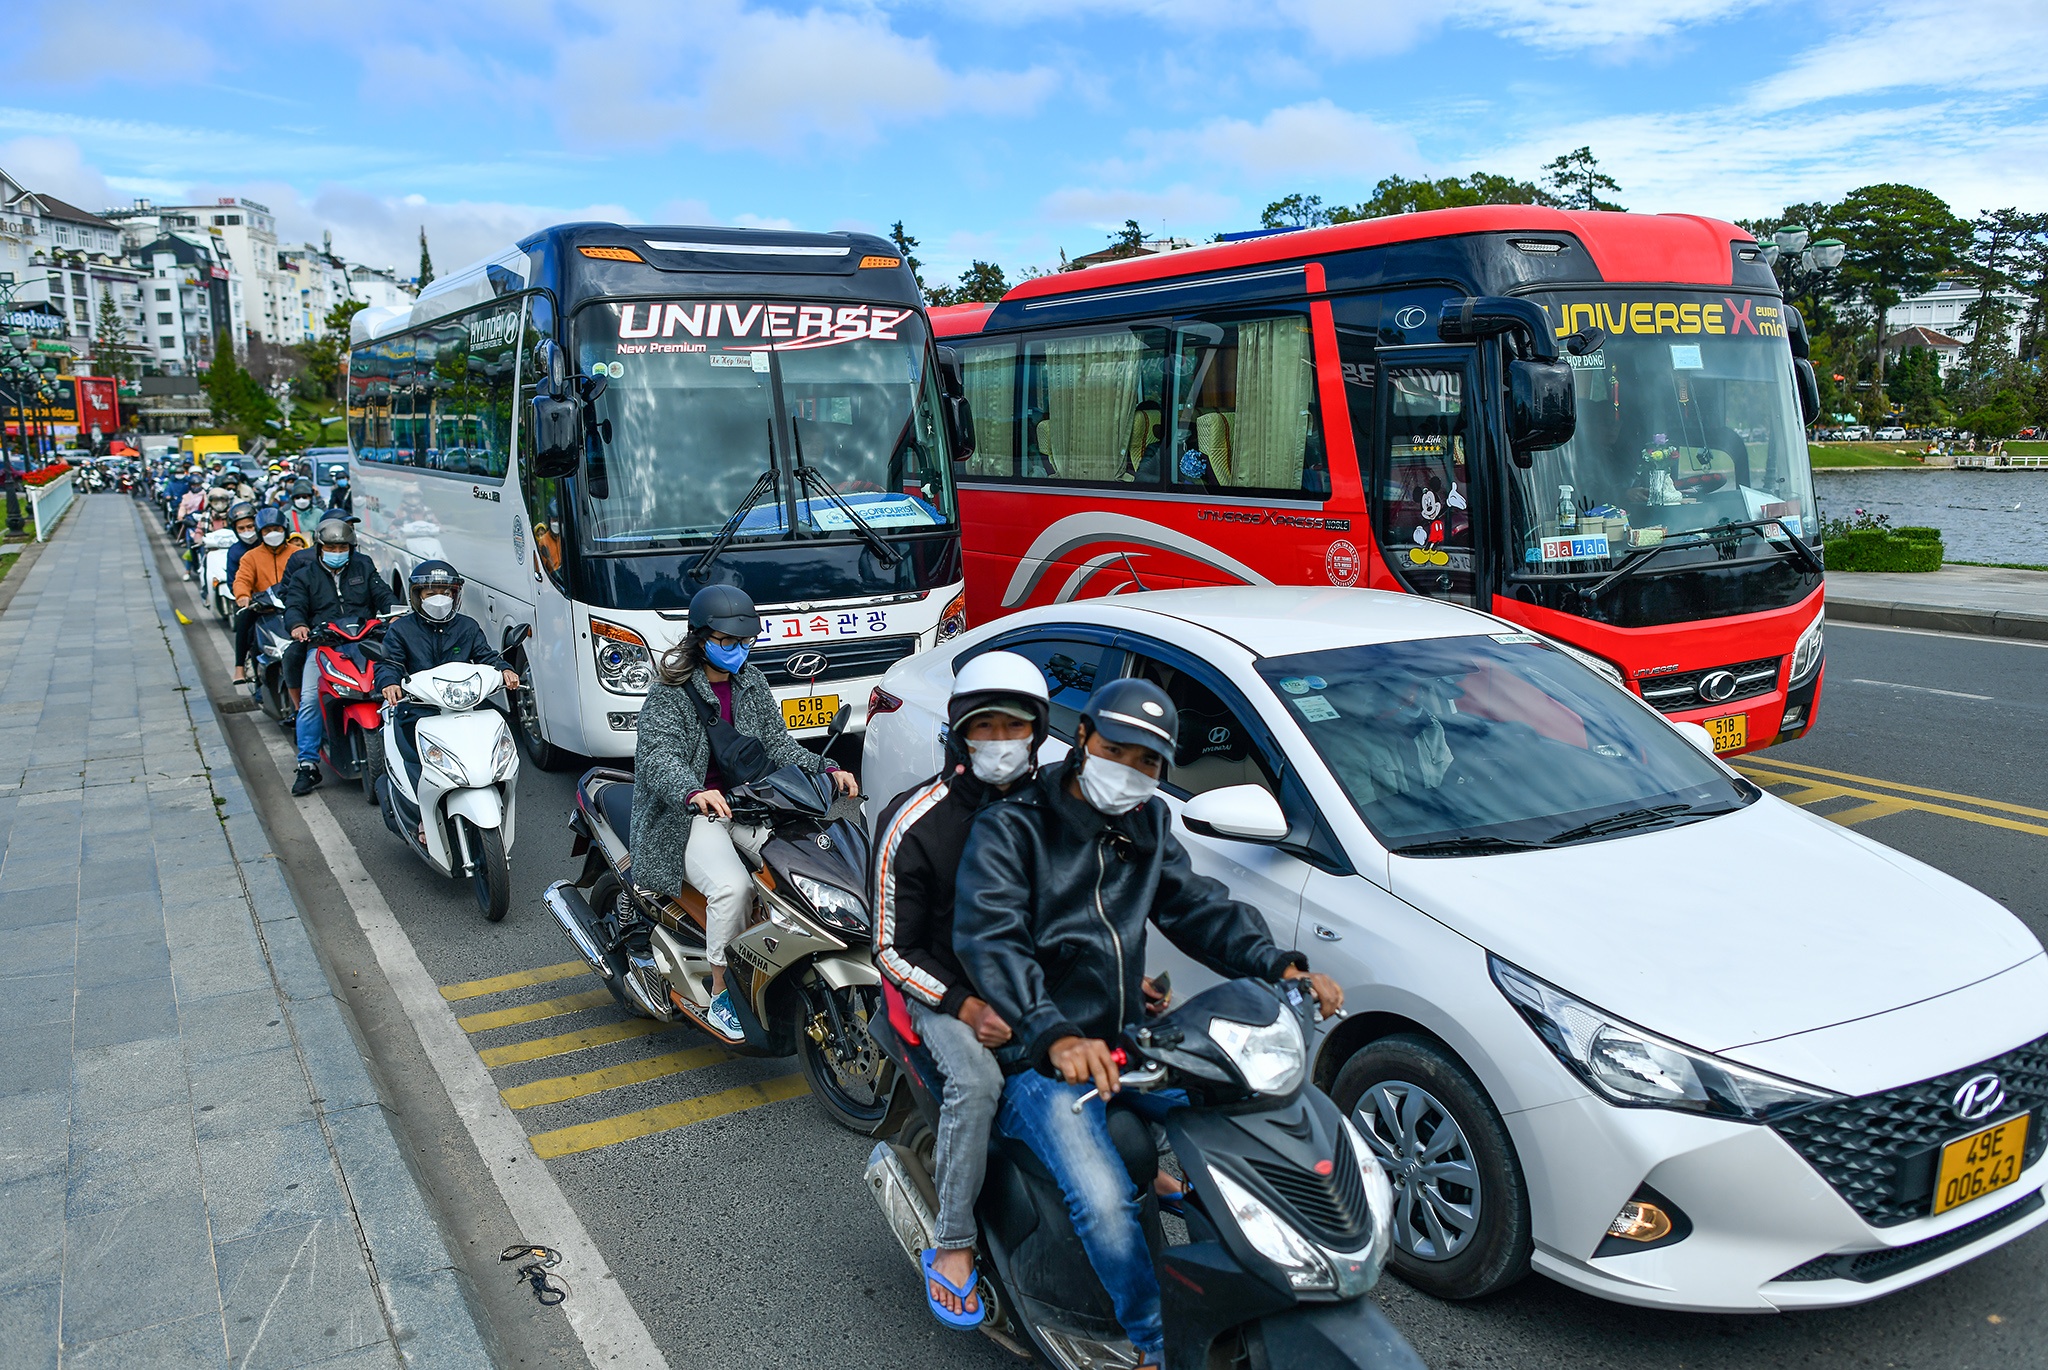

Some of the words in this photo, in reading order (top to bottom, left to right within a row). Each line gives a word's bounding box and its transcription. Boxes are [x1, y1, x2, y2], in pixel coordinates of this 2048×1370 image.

[470, 314, 504, 344] HYUNDAI
[617, 303, 899, 341] UNIVERSE
[617, 343, 647, 355] New
[650, 341, 707, 353] Premium
[1198, 509, 1262, 524] UNIVERSE
[1546, 541, 1606, 558] Bazan
[1633, 664, 1679, 677] UNIVERSE
[798, 698, 823, 712] 61B
[789, 711, 833, 728] 024.63
[1716, 718, 1735, 735] 51B
[1202, 744, 1233, 754] HYUNDAI
[1713, 732, 1742, 751] 63.23
[739, 943, 768, 972] YAMAHA
[1966, 1127, 2005, 1166] 49E
[1944, 1154, 2015, 1208] 006.43
